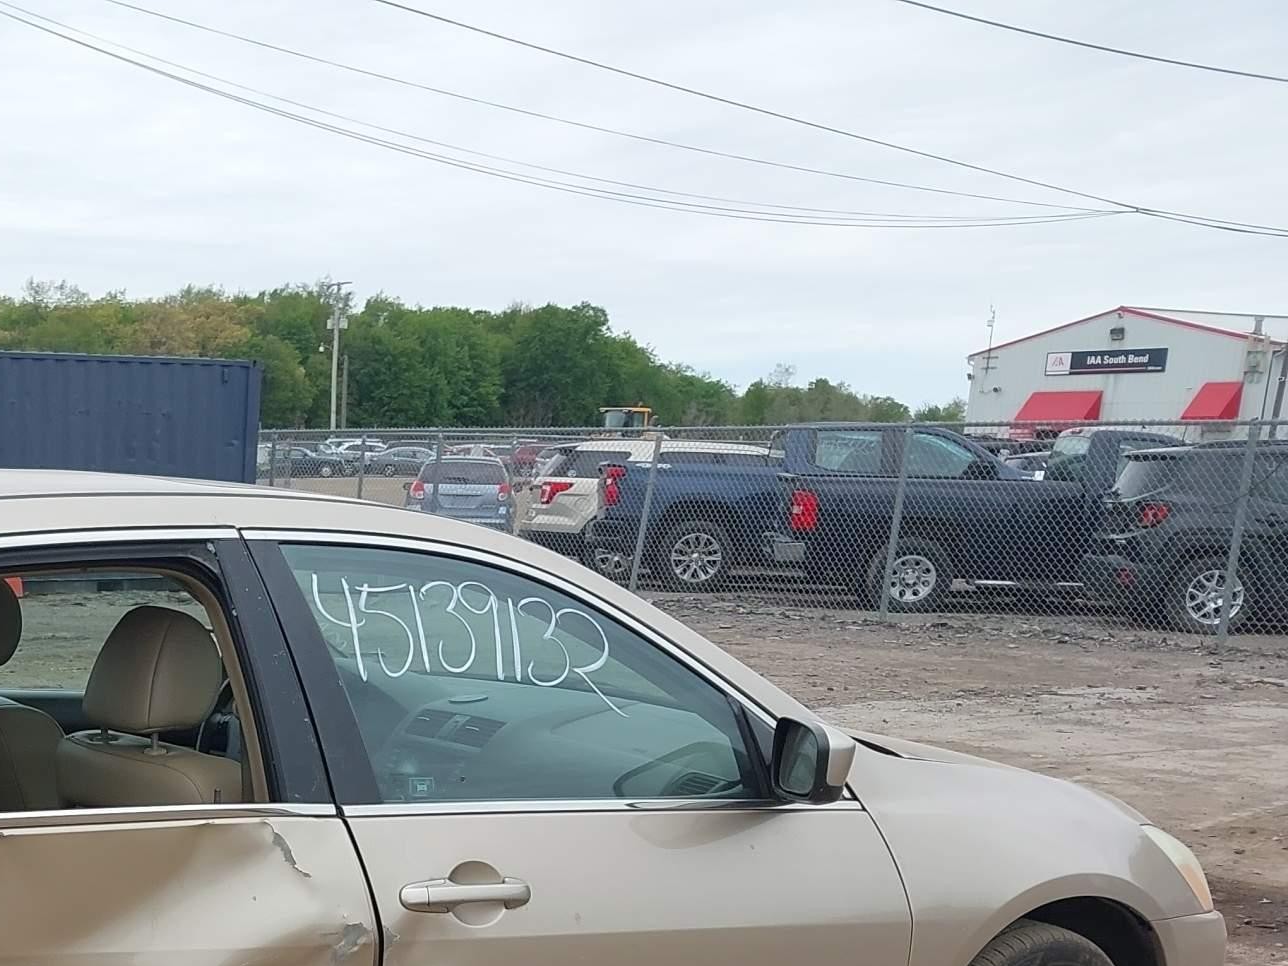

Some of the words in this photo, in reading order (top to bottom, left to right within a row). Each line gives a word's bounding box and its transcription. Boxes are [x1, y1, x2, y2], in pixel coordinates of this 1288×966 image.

[1086, 355, 1102, 365] IAA
[1103, 354, 1126, 365] South
[1128, 354, 1150, 363] Bend
[311, 572, 630, 718] 45139132
